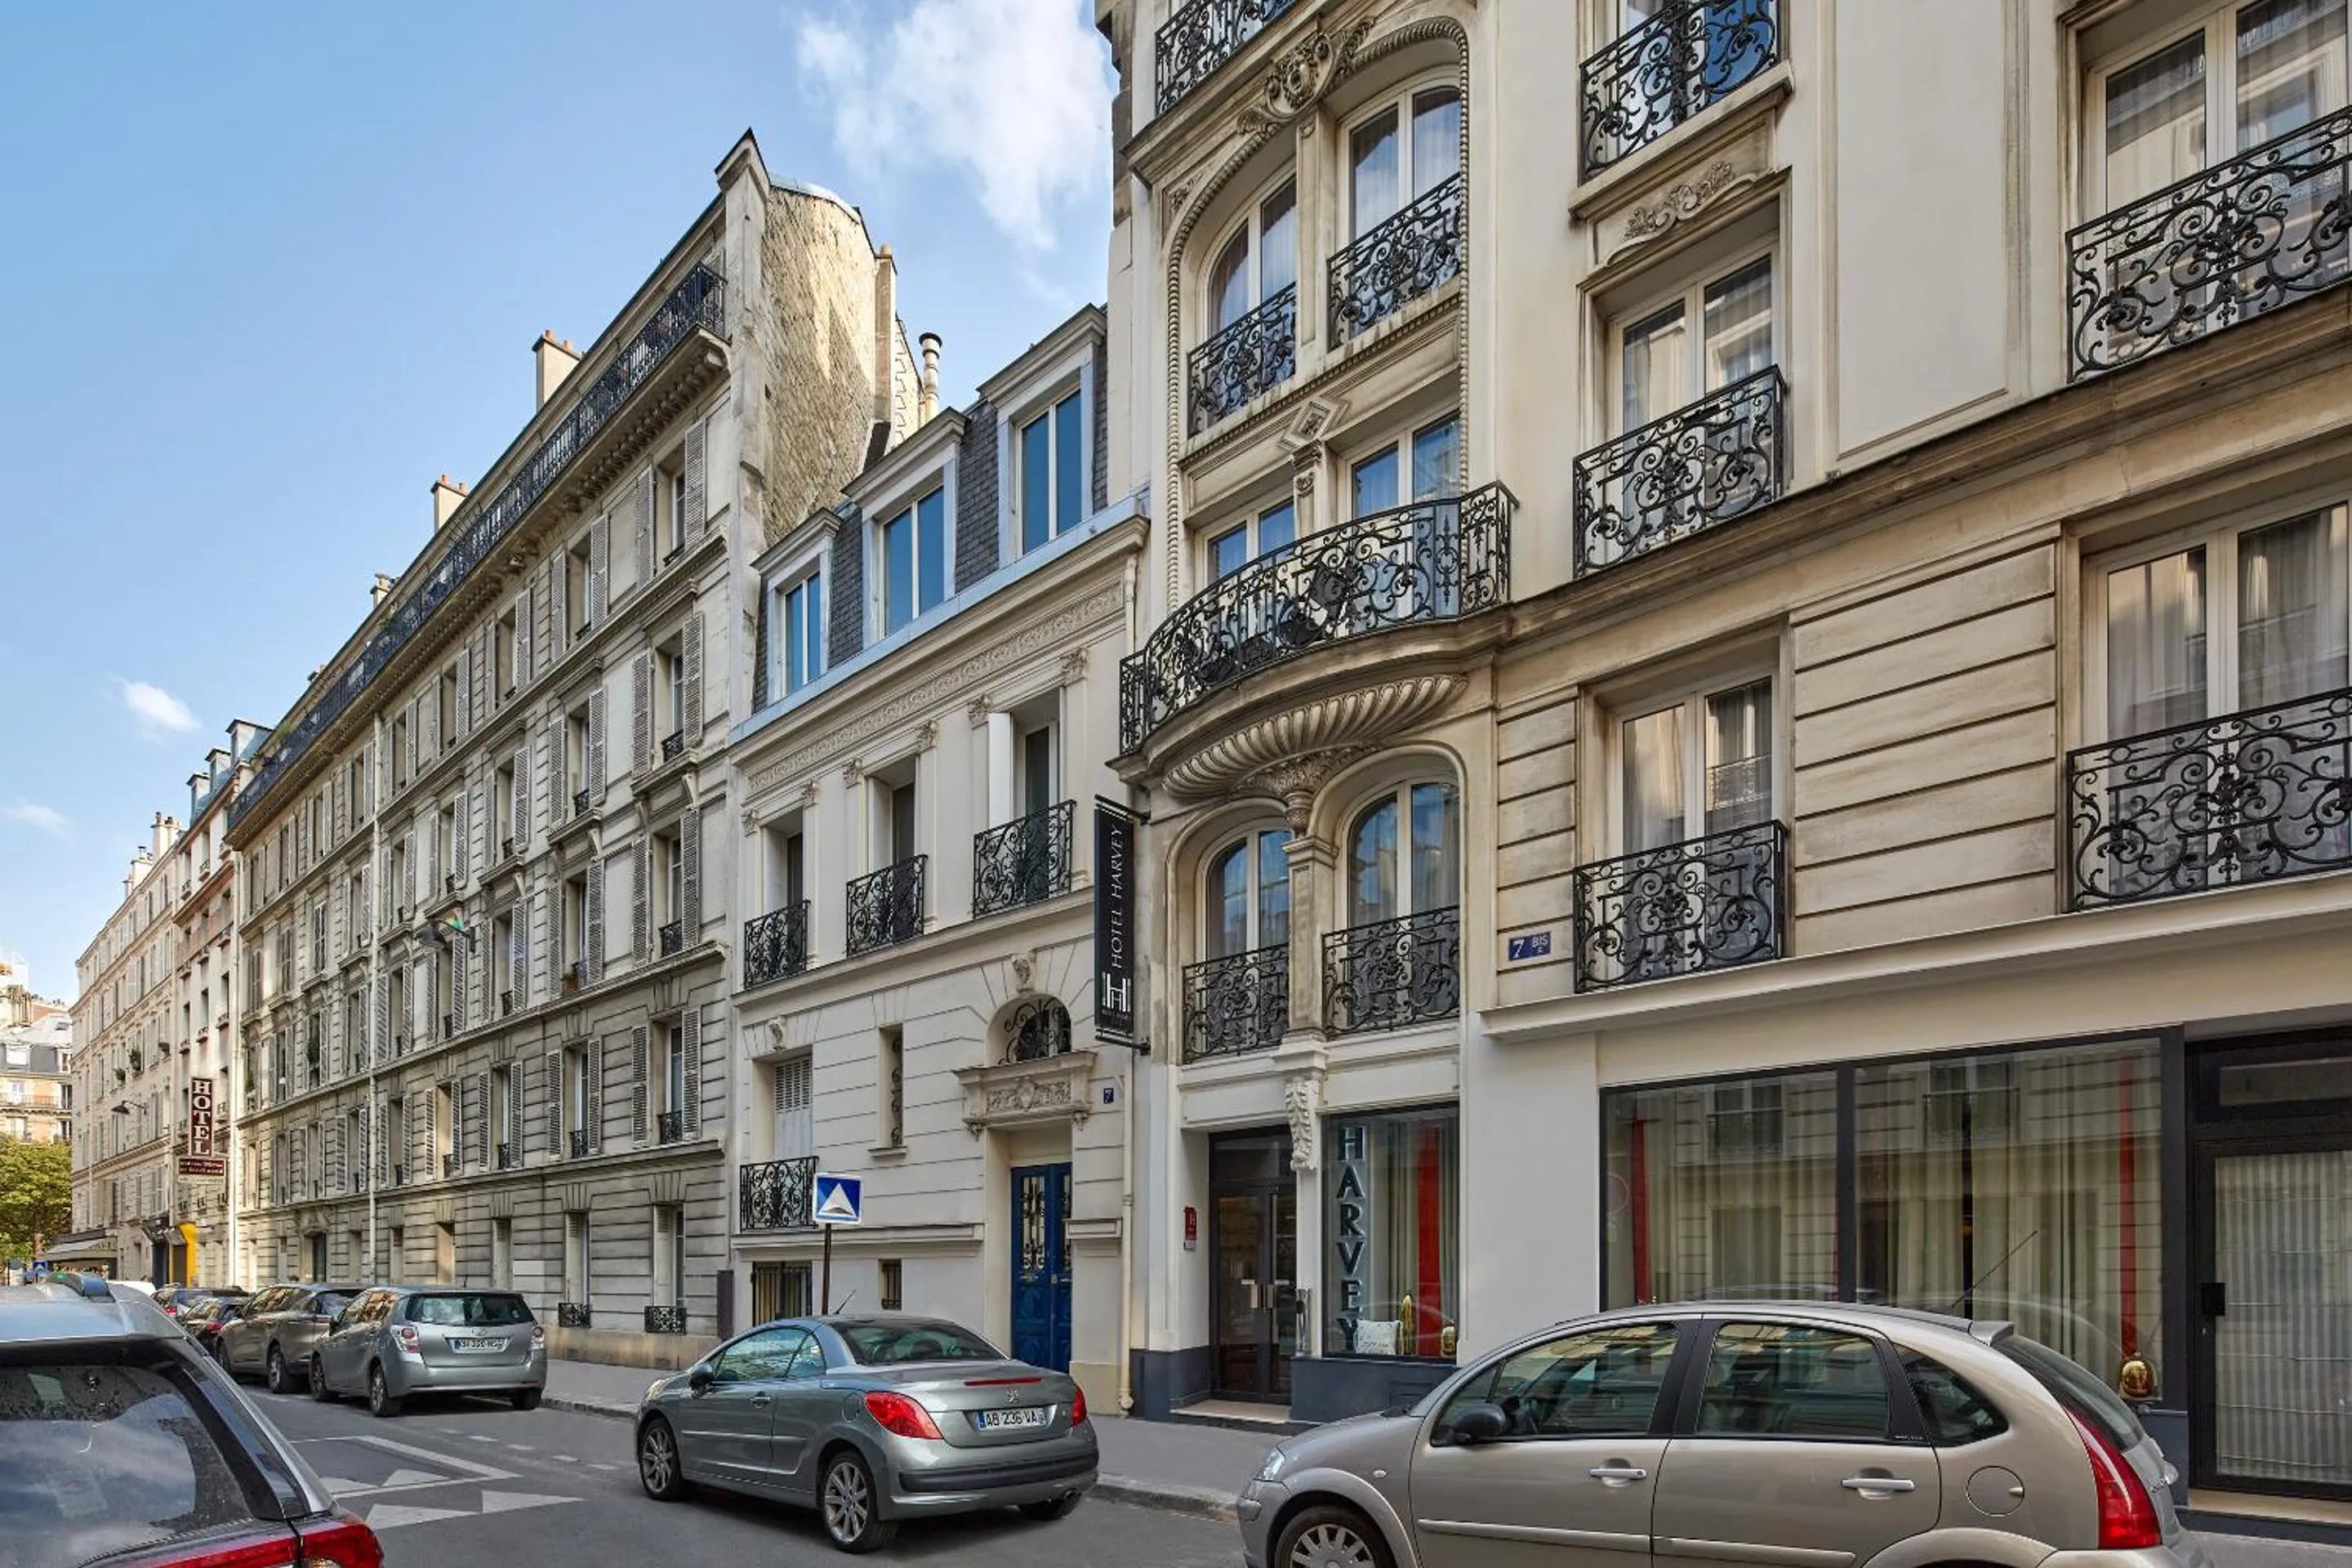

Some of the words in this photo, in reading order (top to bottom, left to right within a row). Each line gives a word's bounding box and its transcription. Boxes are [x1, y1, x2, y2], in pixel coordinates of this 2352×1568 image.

[1111, 822, 1123, 899] HARVEY
[1111, 908, 1123, 969] HOTEL
[1512, 939, 1525, 959] 7
[1531, 934, 1548, 948] BIS
[193, 1080, 212, 1155] HOTEL
[1336, 1127, 1365, 1354] HARVEY
[1023, 1408, 1038, 1423] VA
